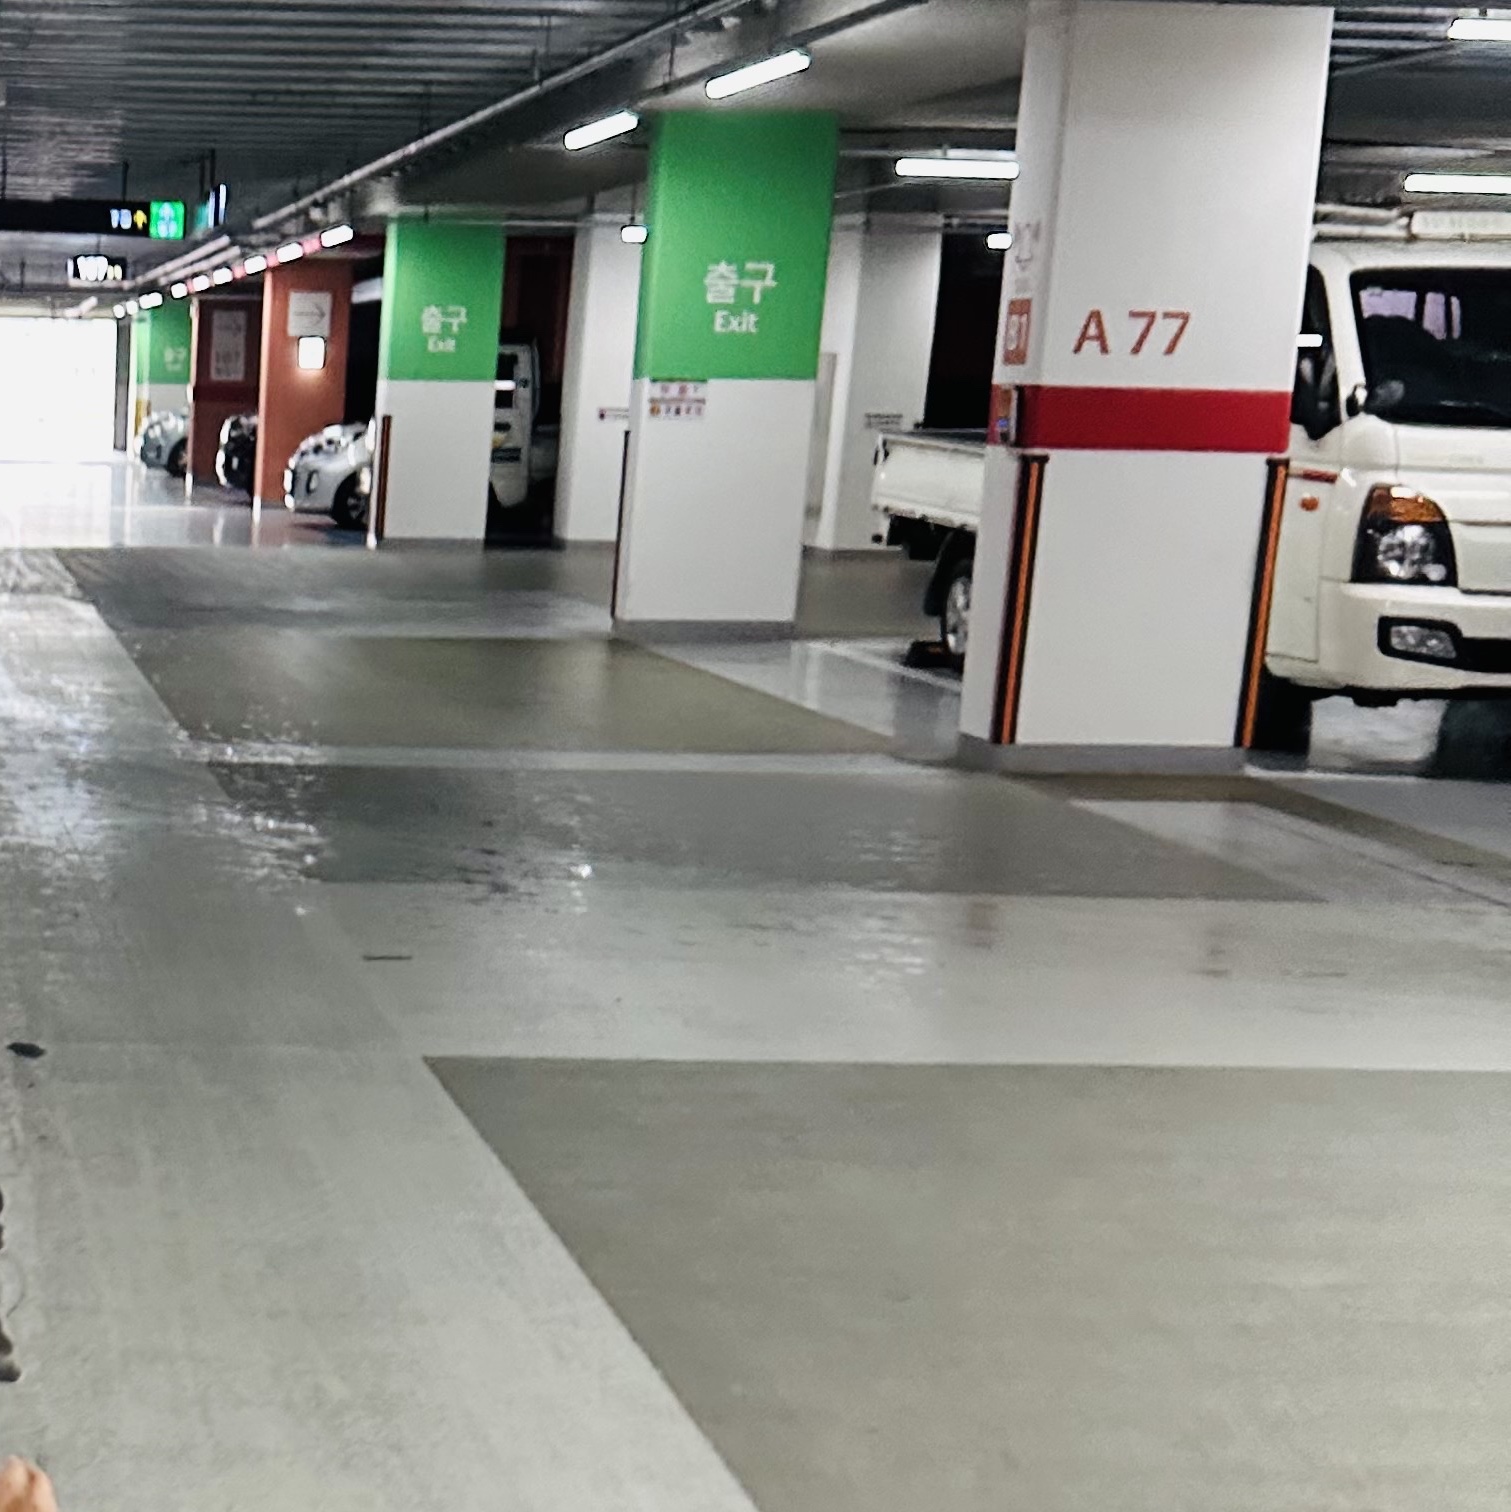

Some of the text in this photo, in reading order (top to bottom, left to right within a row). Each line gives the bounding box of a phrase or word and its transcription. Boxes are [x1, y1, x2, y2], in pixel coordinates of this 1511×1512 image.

[703, 259, 778, 304] 출구
[714, 309, 759, 333] Exit
[1073, 309, 1191, 356] A 77
